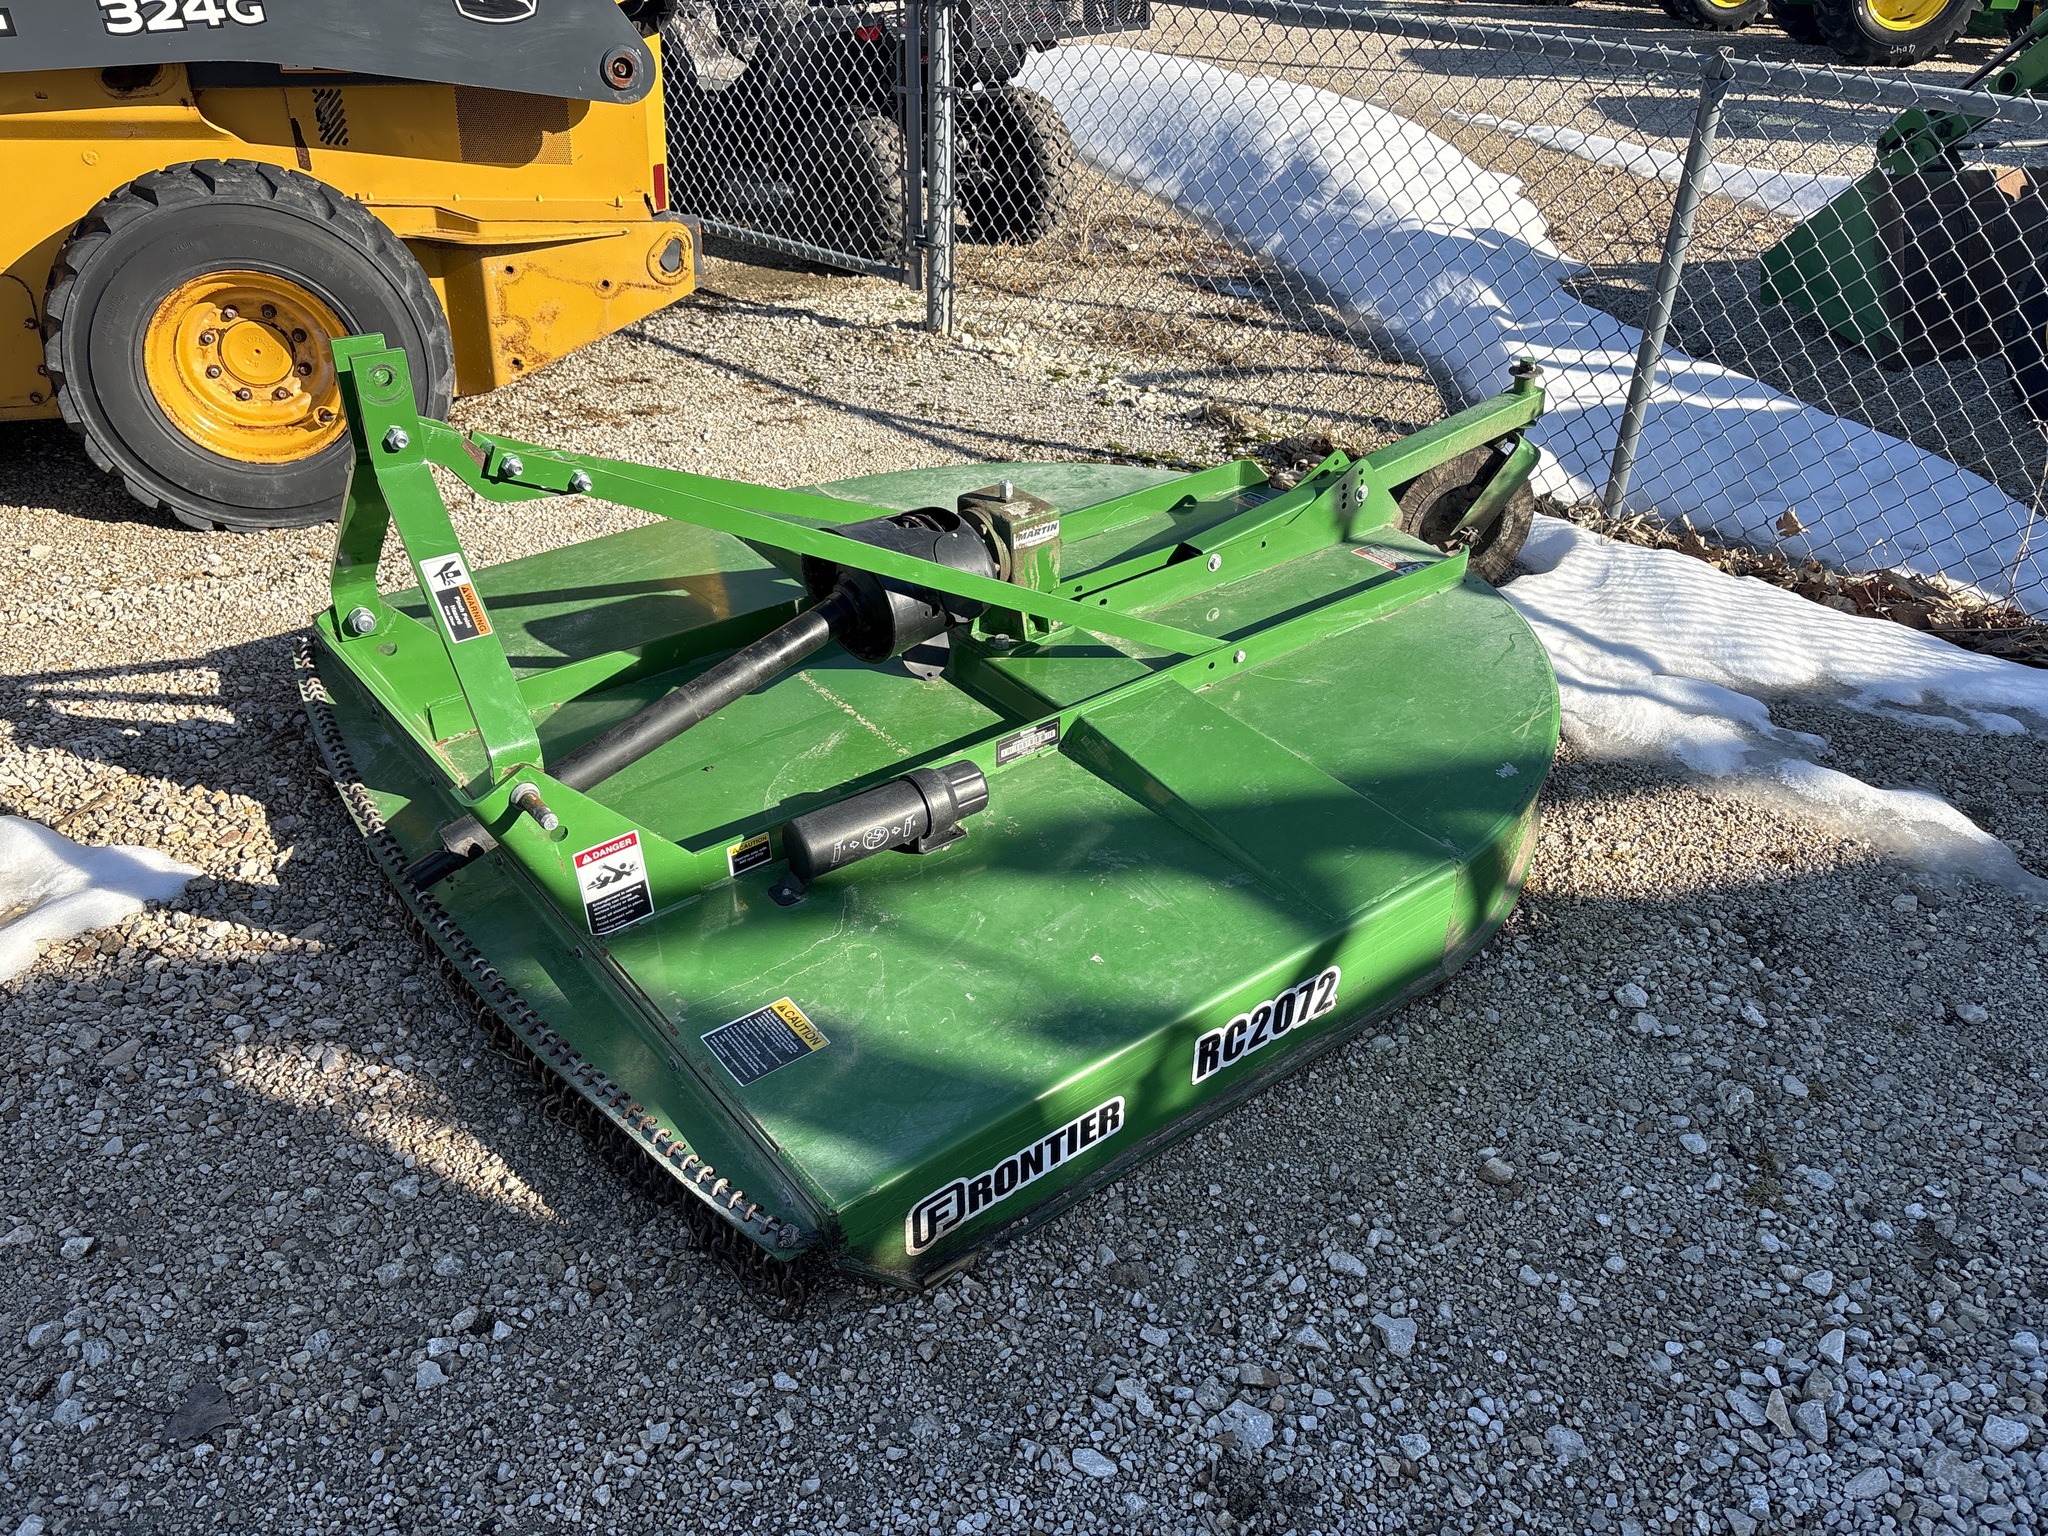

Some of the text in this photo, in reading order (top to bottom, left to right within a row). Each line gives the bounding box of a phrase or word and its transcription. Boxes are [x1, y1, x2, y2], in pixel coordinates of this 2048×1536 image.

[98, 0, 268, 36] 324G
[1018, 522, 1058, 541] MARTIN
[450, 604, 463, 625] Hazard
[454, 596, 472, 628] Pinch Point
[466, 593, 487, 632] WARNING
[592, 838, 632, 860] DANGER
[739, 836, 767, 850] CAUTION
[784, 1010, 822, 1046] CAUTION
[1194, 970, 1338, 1080] RC2072
[911, 1100, 1121, 1250] FRONTIER
